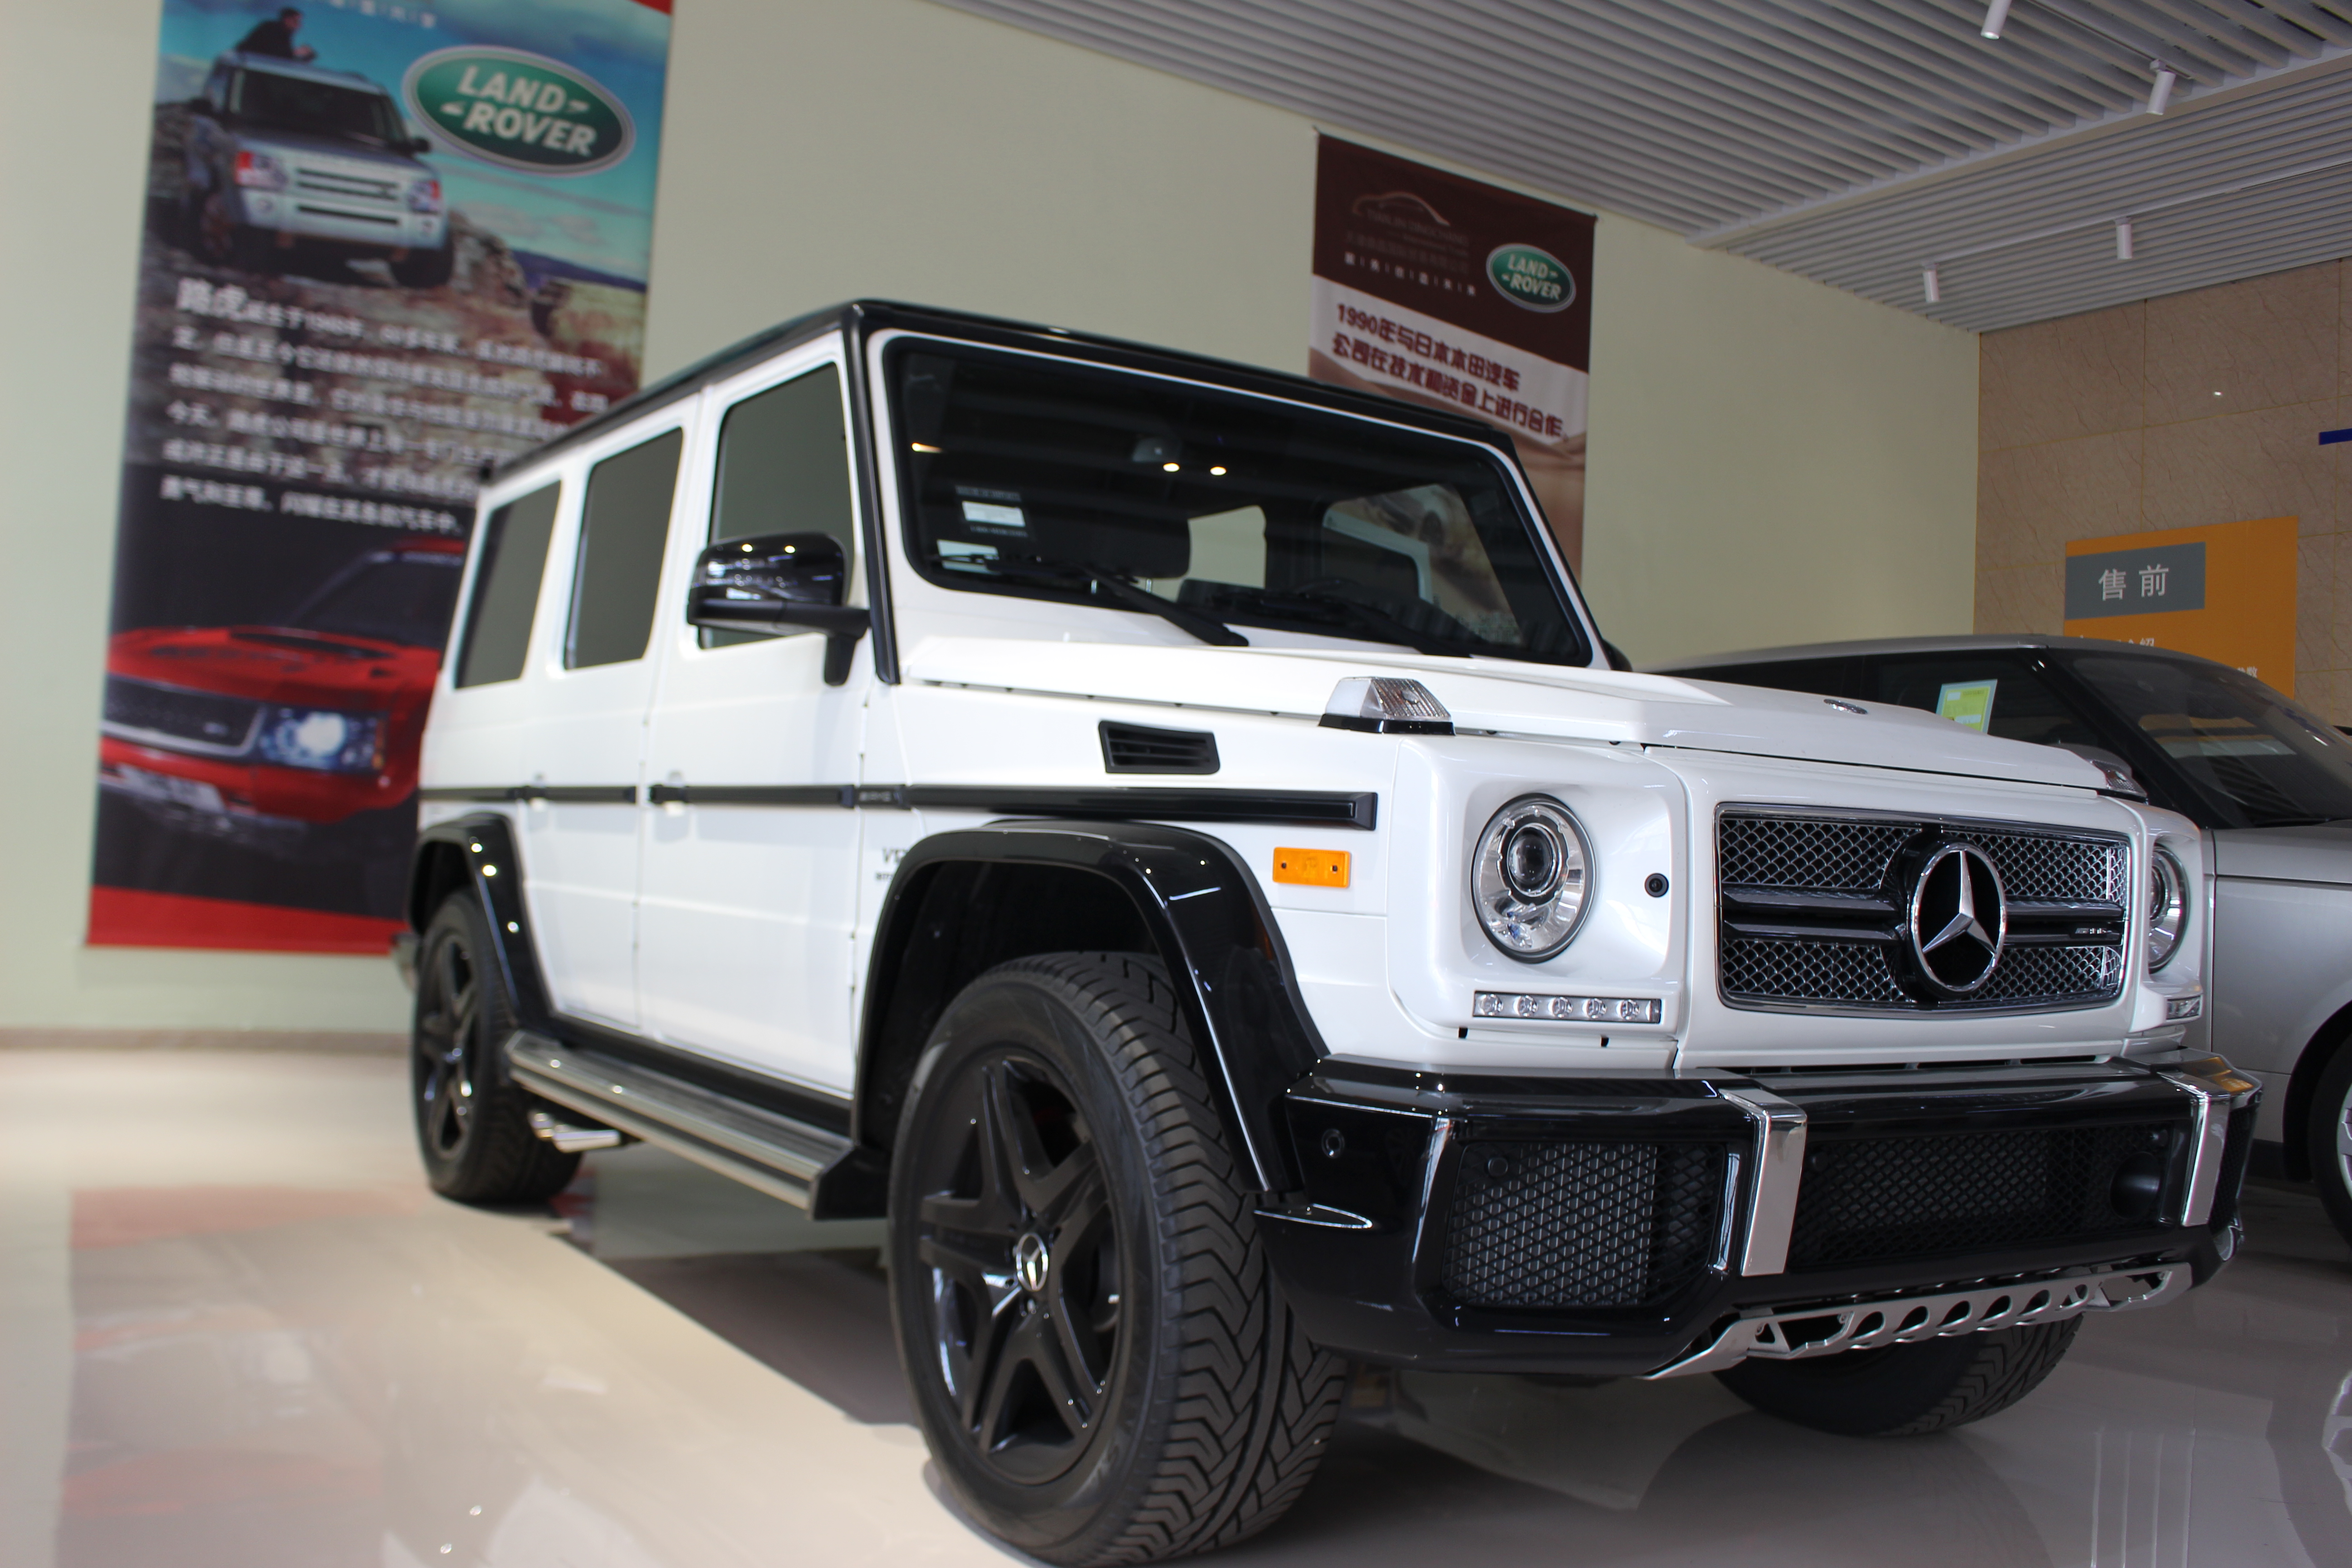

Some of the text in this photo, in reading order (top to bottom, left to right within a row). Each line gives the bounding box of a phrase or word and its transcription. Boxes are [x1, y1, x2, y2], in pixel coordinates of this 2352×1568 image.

[457, 65, 566, 113] LAND
[464, 102, 597, 156] ROVER
[1507, 253, 1549, 279] LAND
[1510, 273, 1561, 300] ROVER
[1337, 303, 1520, 392] 1990年与日本本田汽车
[2098, 564, 2169, 601] 售前
